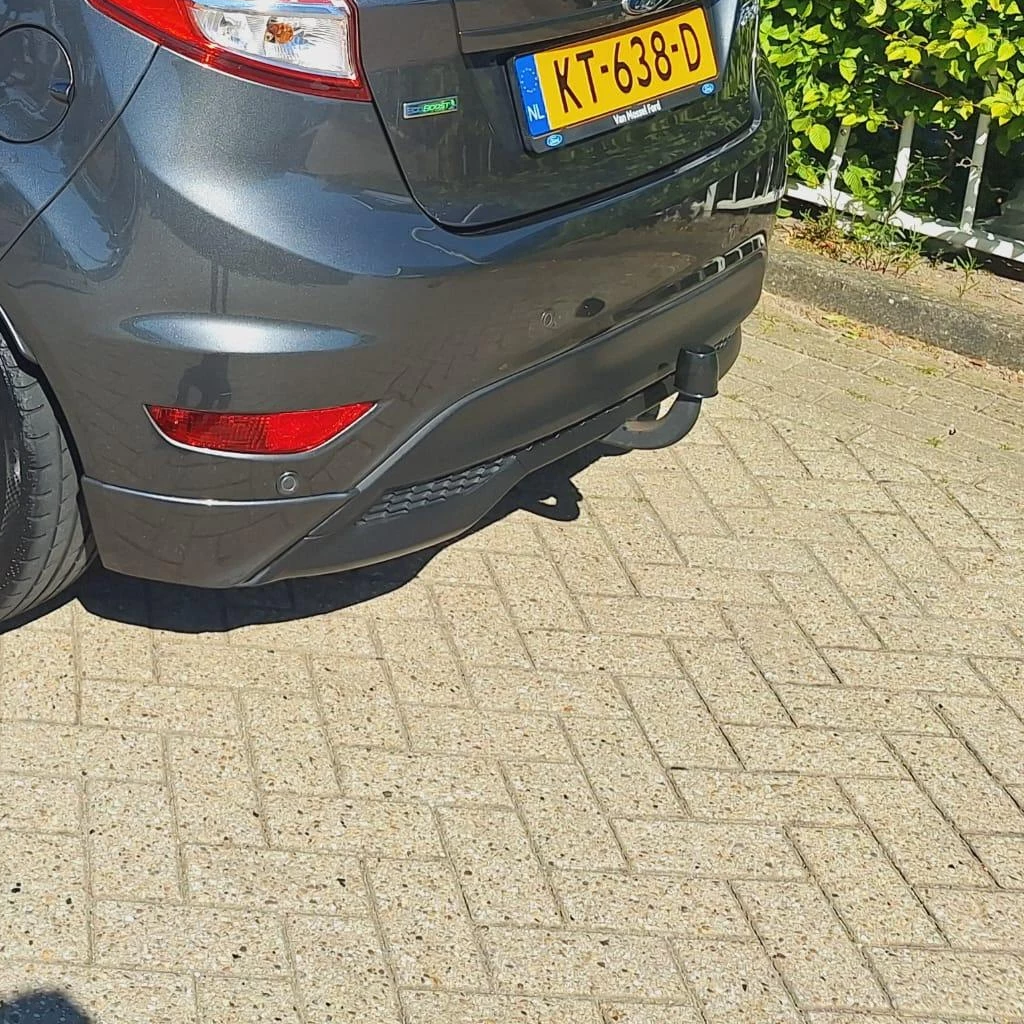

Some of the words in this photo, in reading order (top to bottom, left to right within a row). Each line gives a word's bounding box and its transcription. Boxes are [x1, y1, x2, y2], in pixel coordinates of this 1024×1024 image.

[553, 22, 701, 113] KT-638-D
[527, 104, 545, 122] NL
[613, 113, 627, 125] Van
[626, 105, 649, 121] Mossel
[647, 99, 662, 114] Ford
